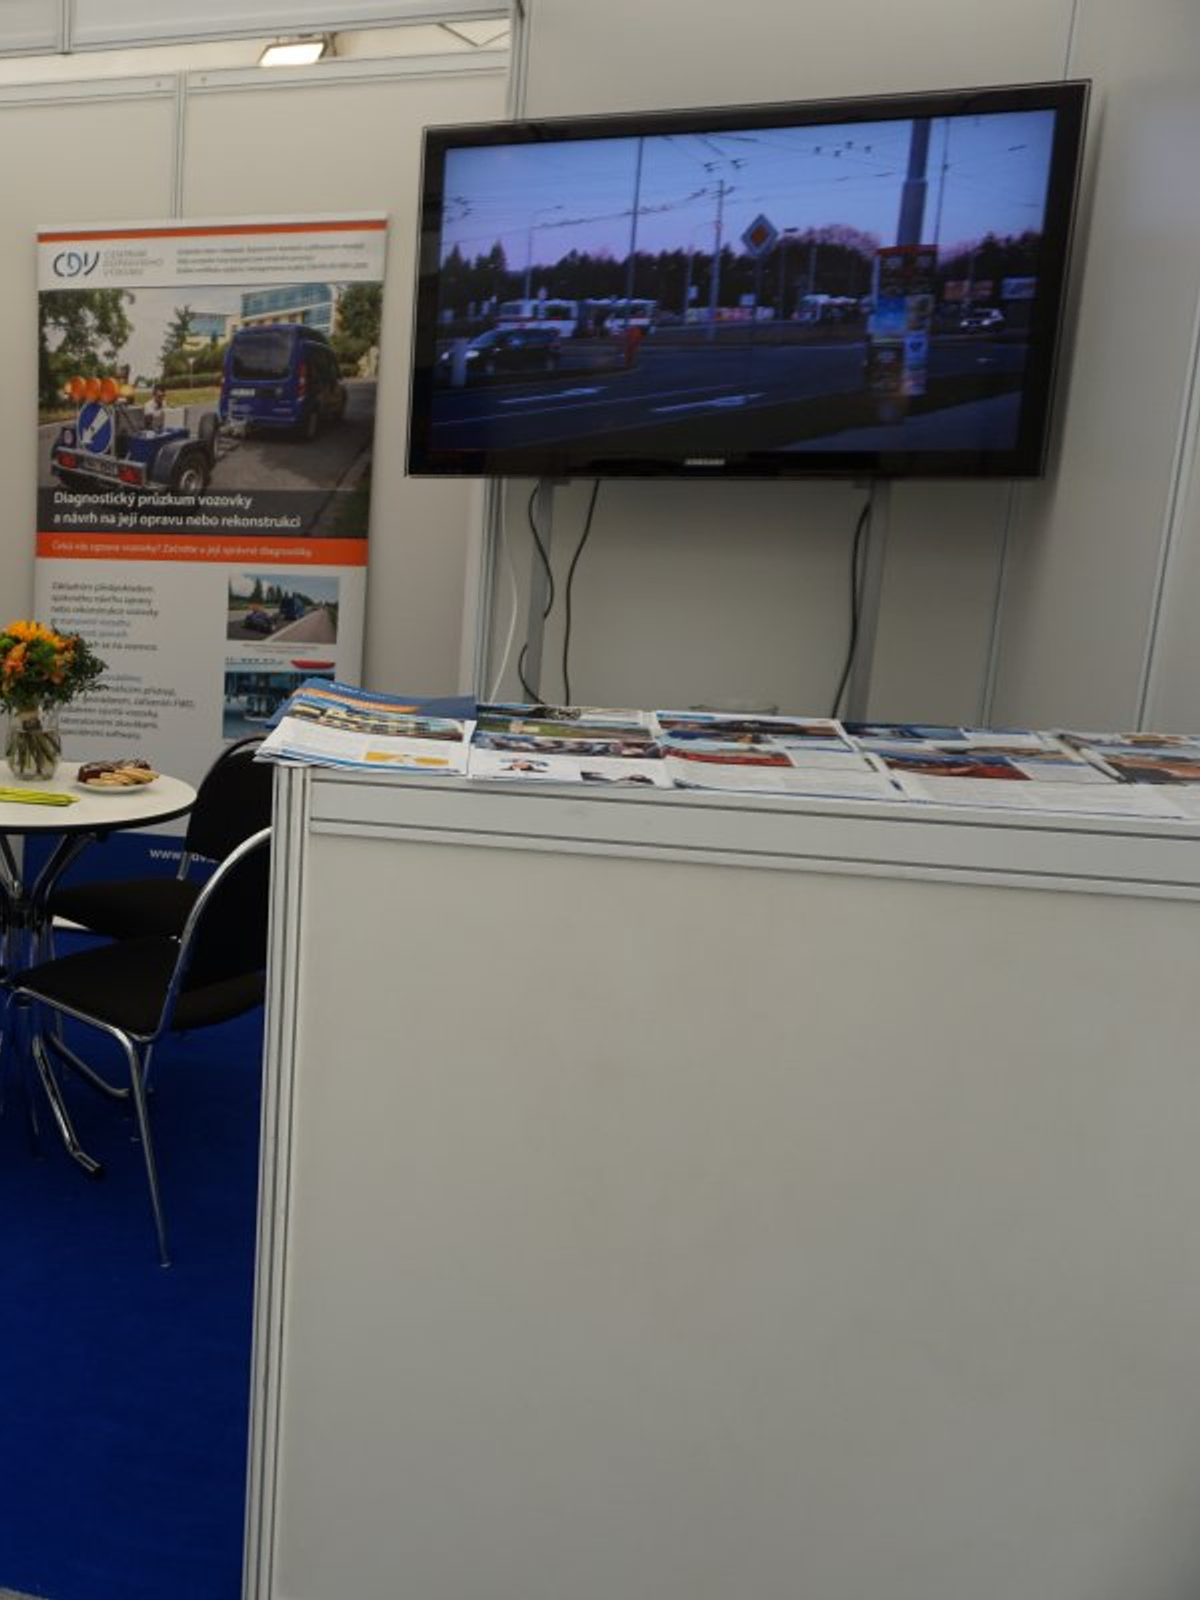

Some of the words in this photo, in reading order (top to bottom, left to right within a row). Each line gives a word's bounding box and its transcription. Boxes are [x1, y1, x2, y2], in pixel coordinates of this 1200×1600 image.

[54, 491, 135, 507] Diagnostický
[138, 492, 195, 507] průzkum
[198, 493, 253, 509] vozovky
[54, 513, 61, 523] a
[62, 511, 98, 524] návrh
[100, 514, 116, 524] na
[118, 512, 137, 527] její
[140, 514, 183, 528] opravu
[186, 514, 219, 526] nebo
[221, 514, 301, 528] rekonstrukci
